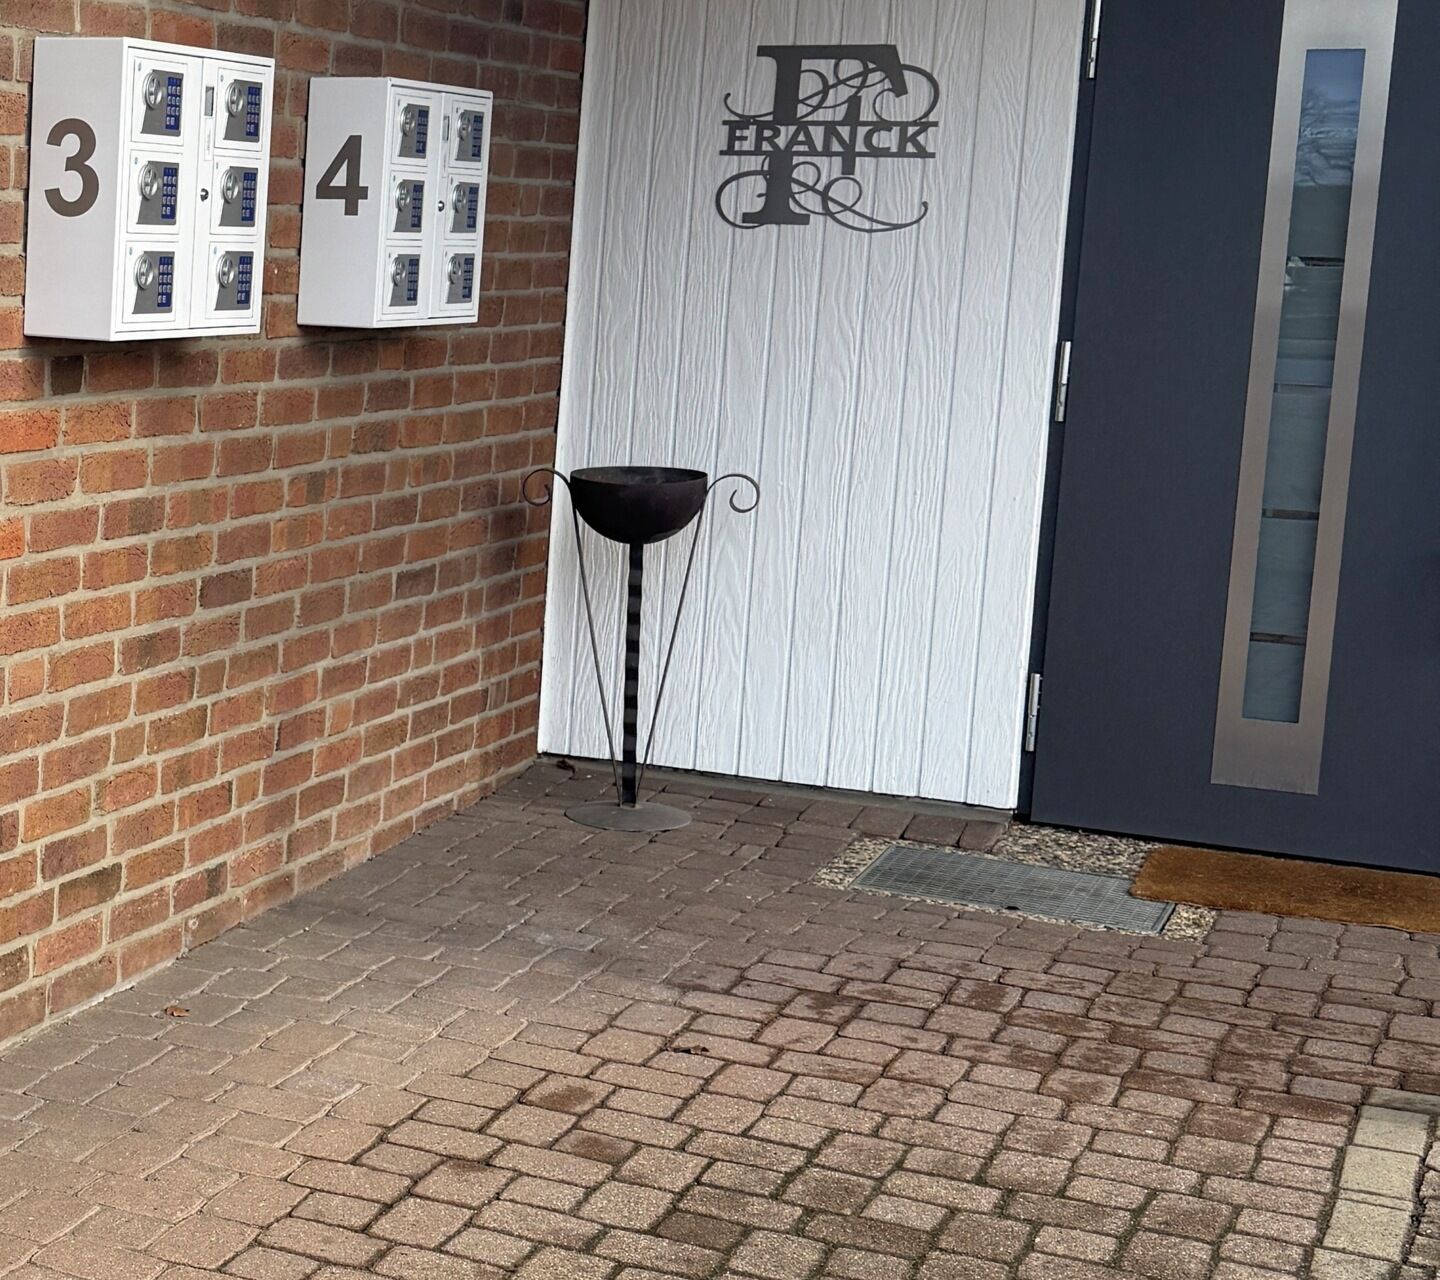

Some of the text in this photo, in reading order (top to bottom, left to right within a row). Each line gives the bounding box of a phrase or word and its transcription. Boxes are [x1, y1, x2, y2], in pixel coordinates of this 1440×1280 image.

[45, 118, 99, 217] 3
[316, 135, 368, 216] 4
[725, 122, 931, 154] FRANCK
